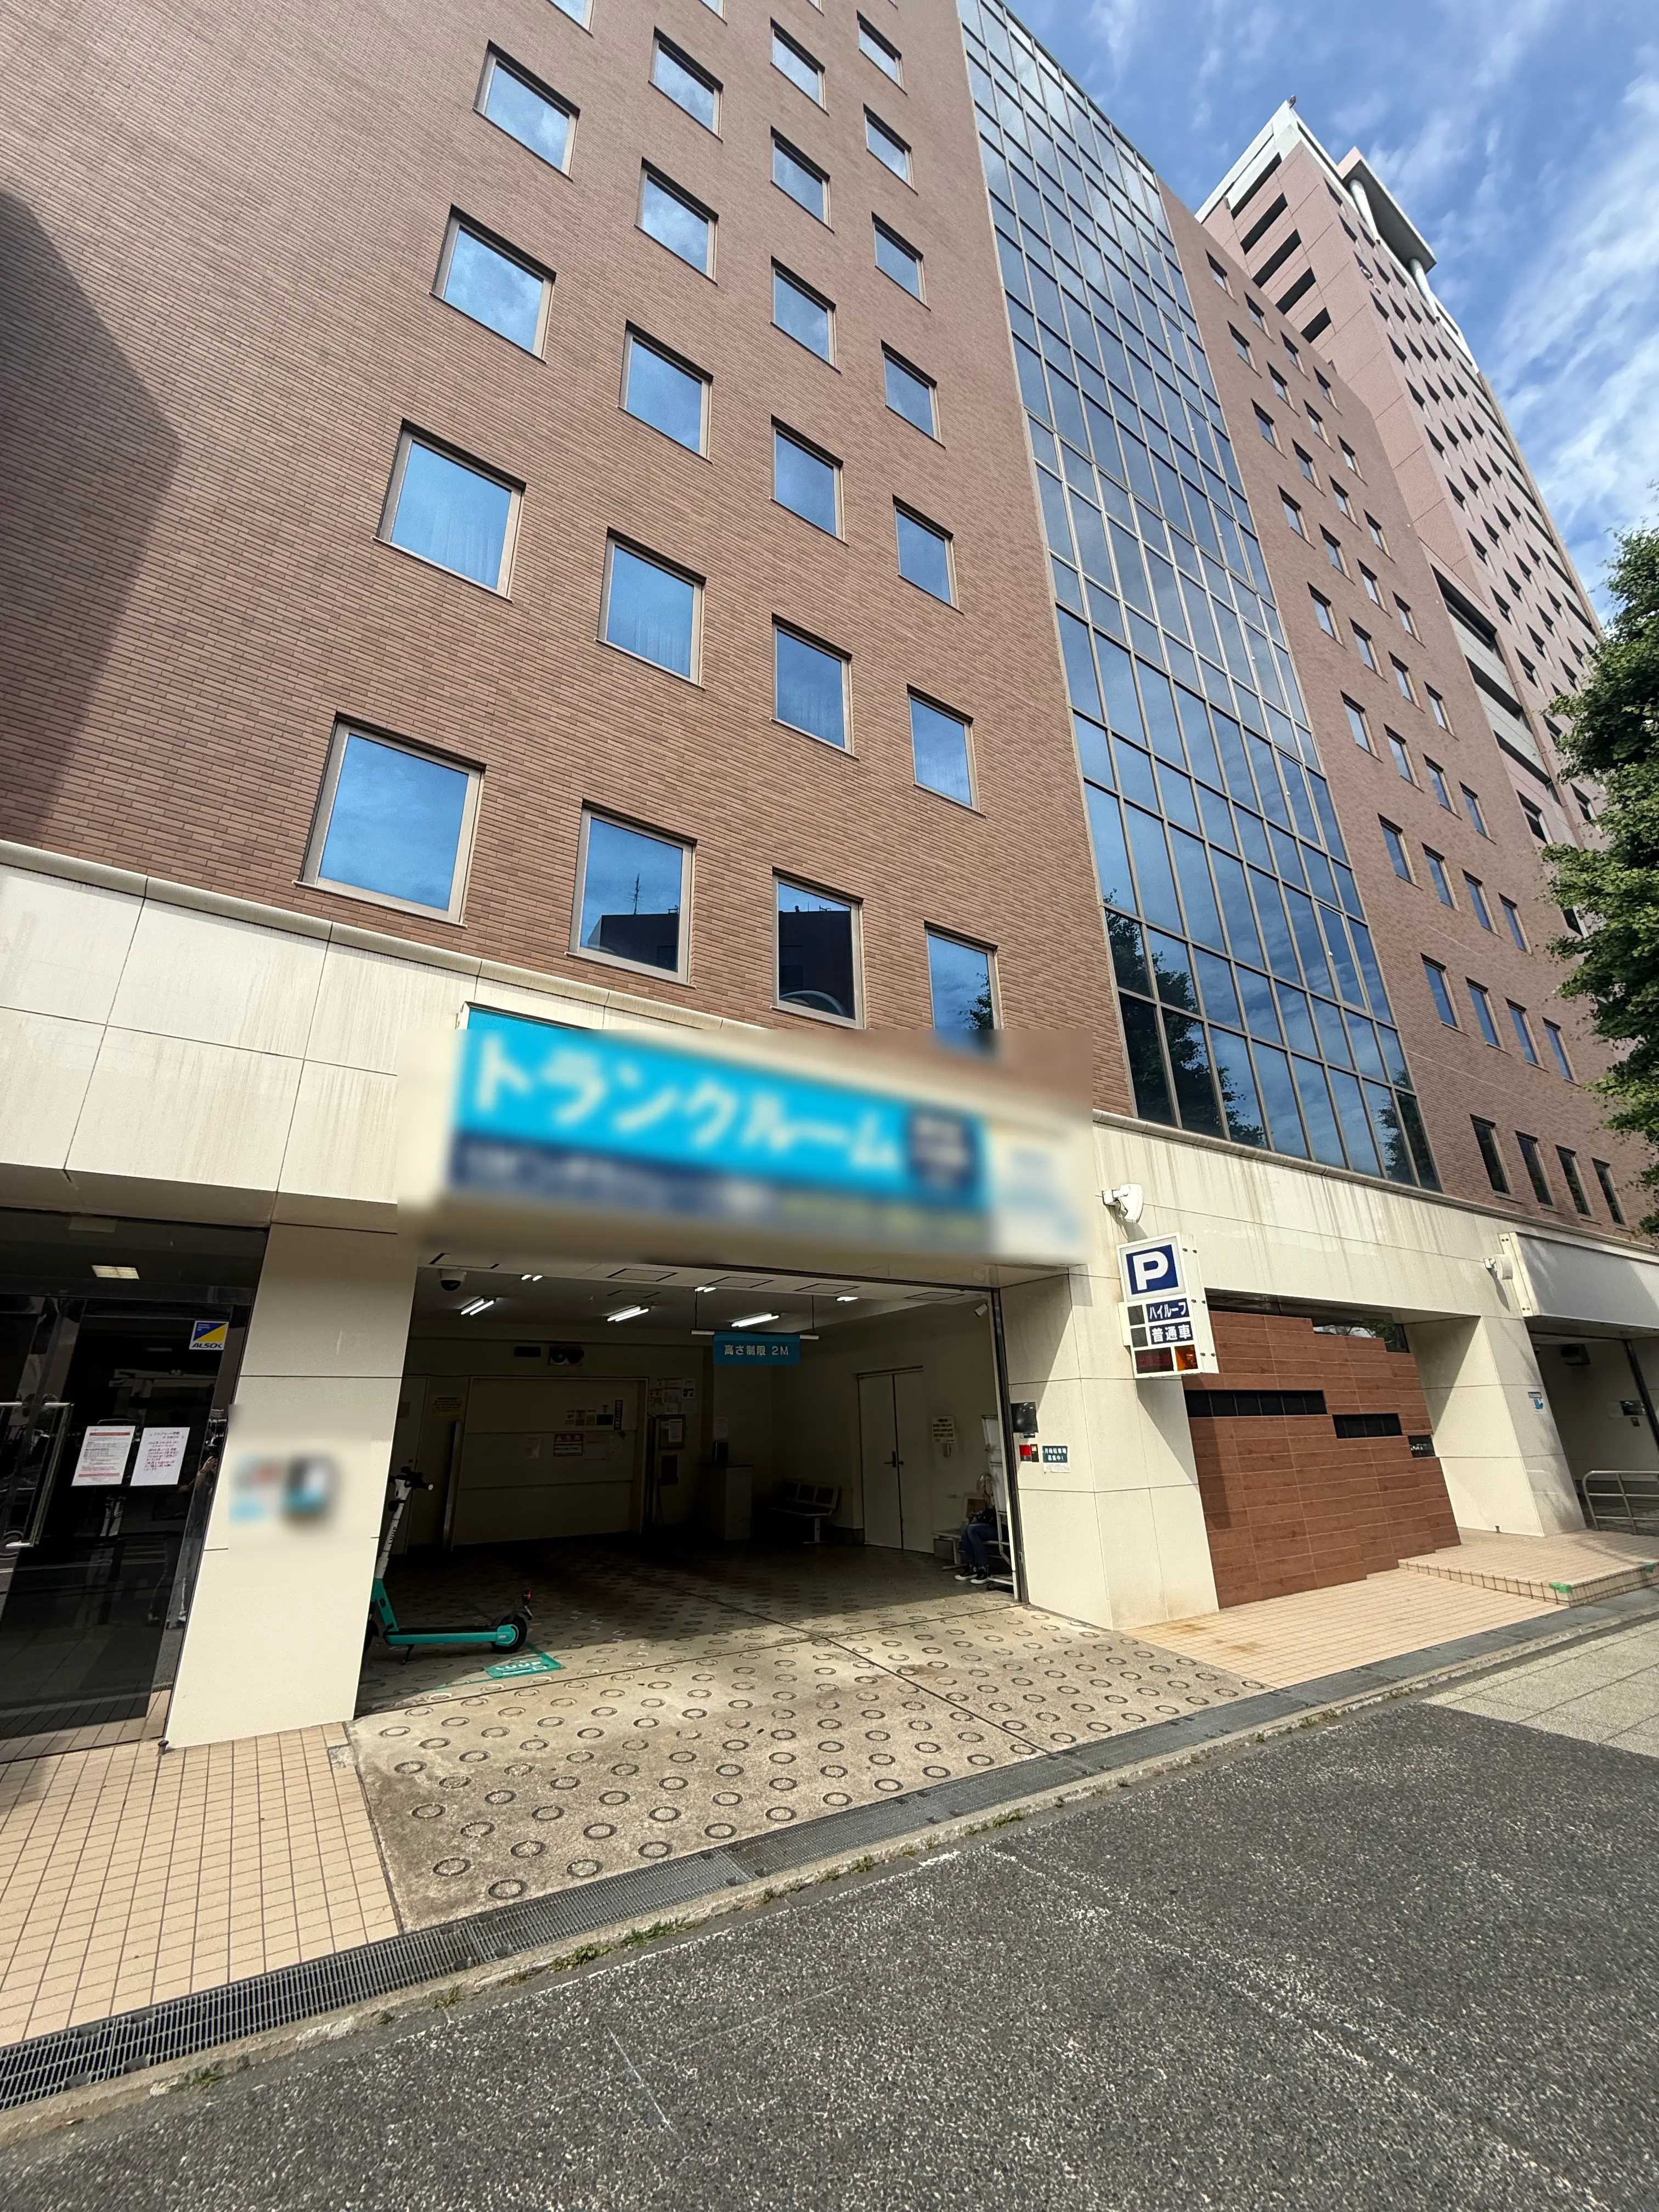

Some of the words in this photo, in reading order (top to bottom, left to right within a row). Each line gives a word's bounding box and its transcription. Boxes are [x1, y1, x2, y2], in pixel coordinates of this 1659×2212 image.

[1132, 1251, 1169, 1291] P
[1149, 1302, 1187, 1321] ハイルーフ
[1152, 1323, 1192, 1343] 普通車
[724, 1345, 766, 1356] 高さ制限
[771, 1346, 789, 1356] 2M
